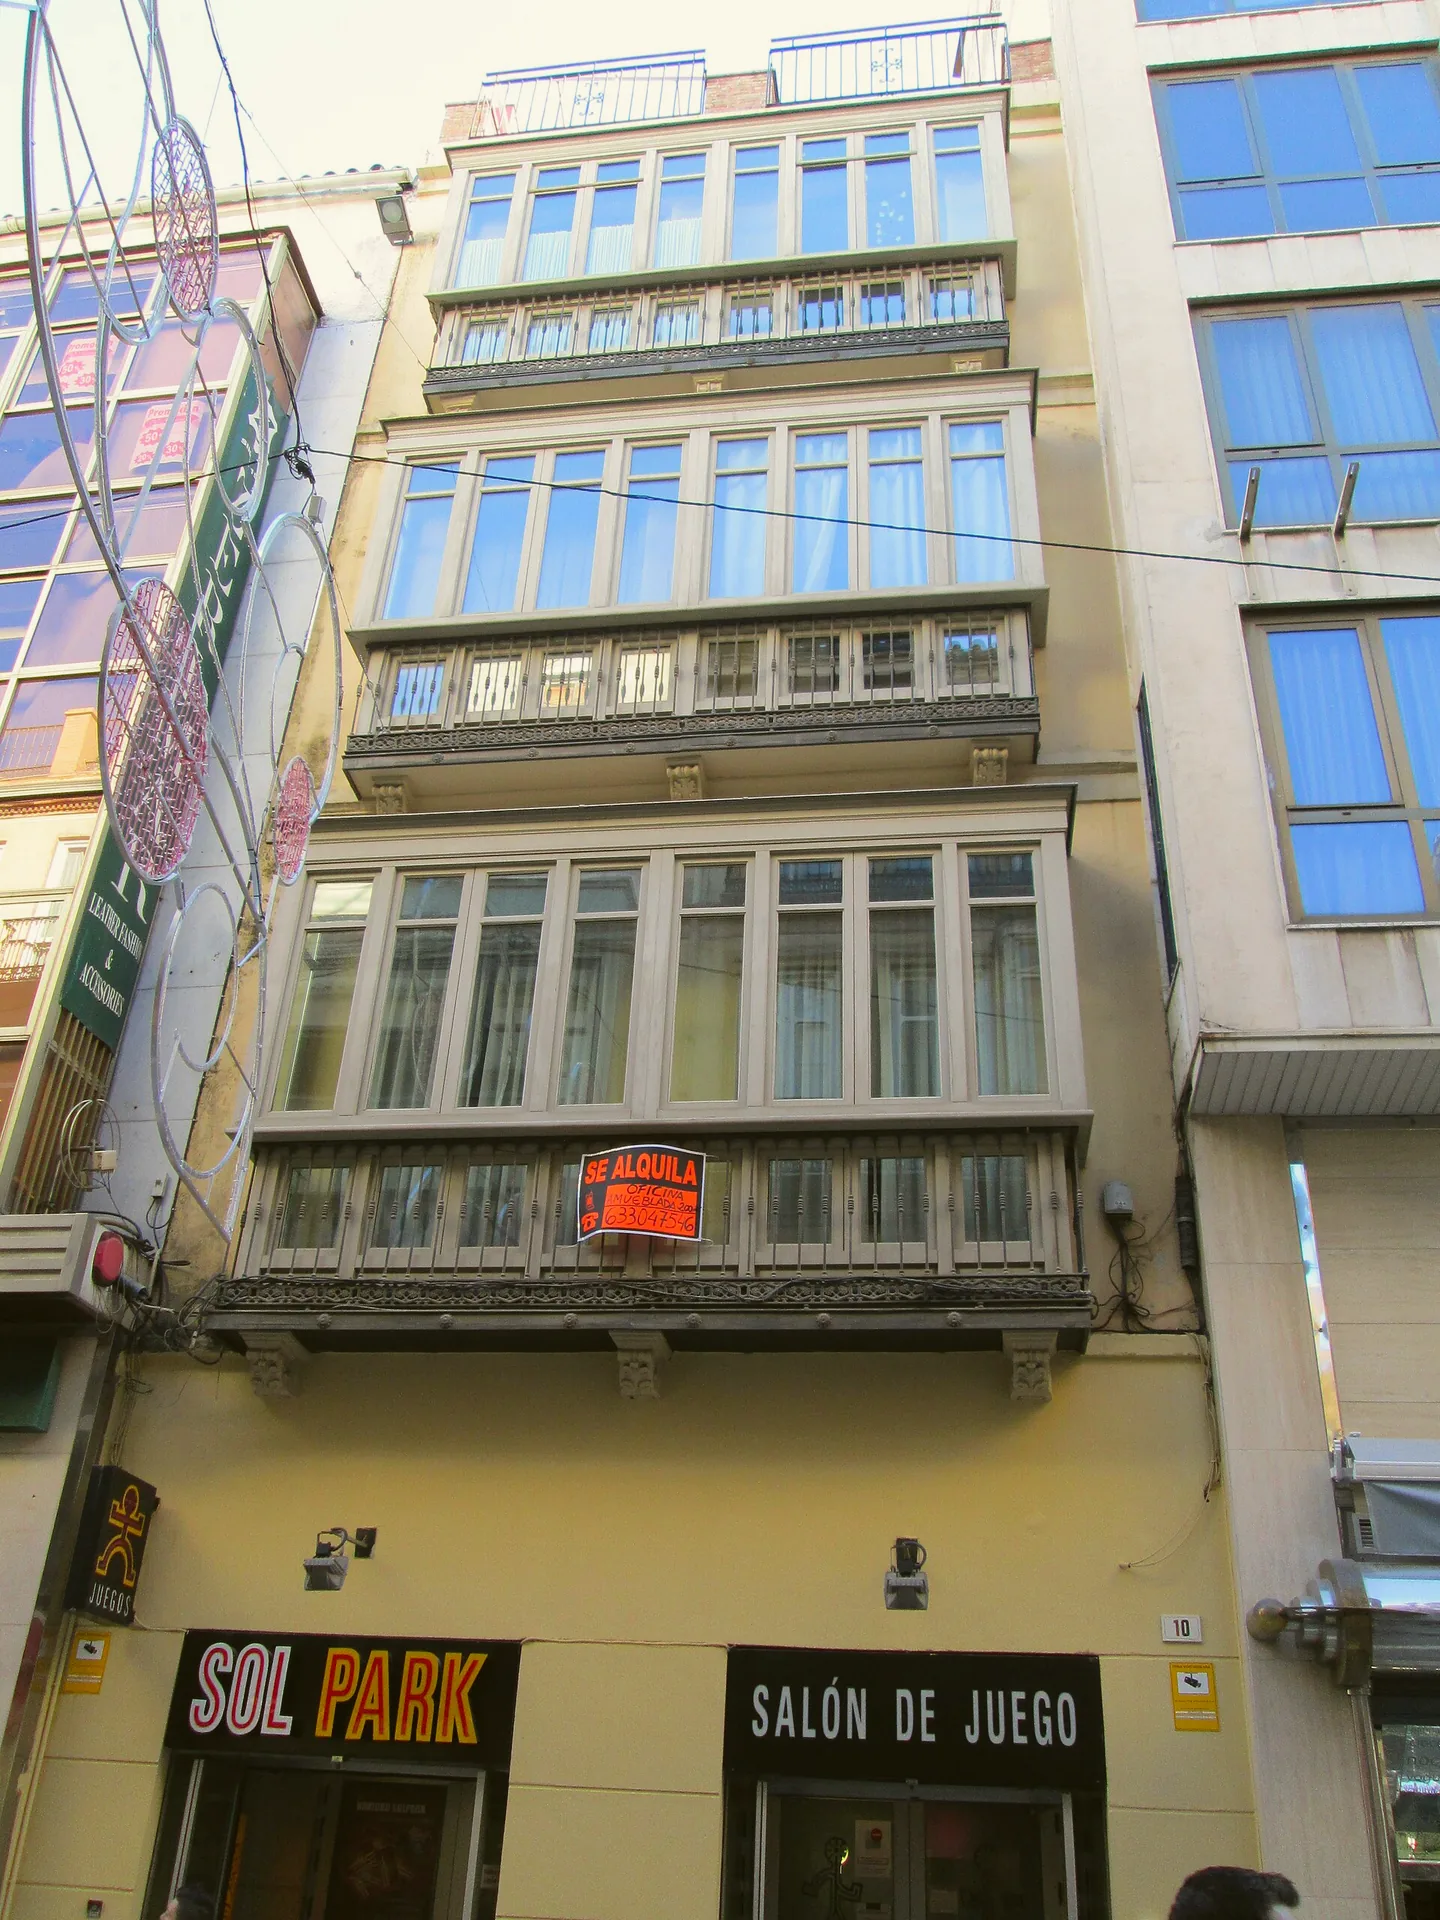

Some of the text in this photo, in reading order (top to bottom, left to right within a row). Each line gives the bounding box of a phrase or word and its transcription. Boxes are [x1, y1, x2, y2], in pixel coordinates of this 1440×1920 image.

[88, 891, 121, 939] LEATHER
[104, 948, 114, 970] &
[78, 961, 126, 1018] ACCESSORIES
[584, 1152, 698, 1186] SE ALQUILA
[606, 1193, 676, 1210] AMUEBLADA
[626, 1184, 684, 1201] OFICINA
[605, 1206, 694, 1232] 633047546
[89, 1582, 132, 1617] JUEGOS
[1173, 1619, 1190, 1637] 10
[188, 1641, 489, 1745] SOL PARK
[751, 1676, 1078, 1747] SALÓN DE JUEGO
